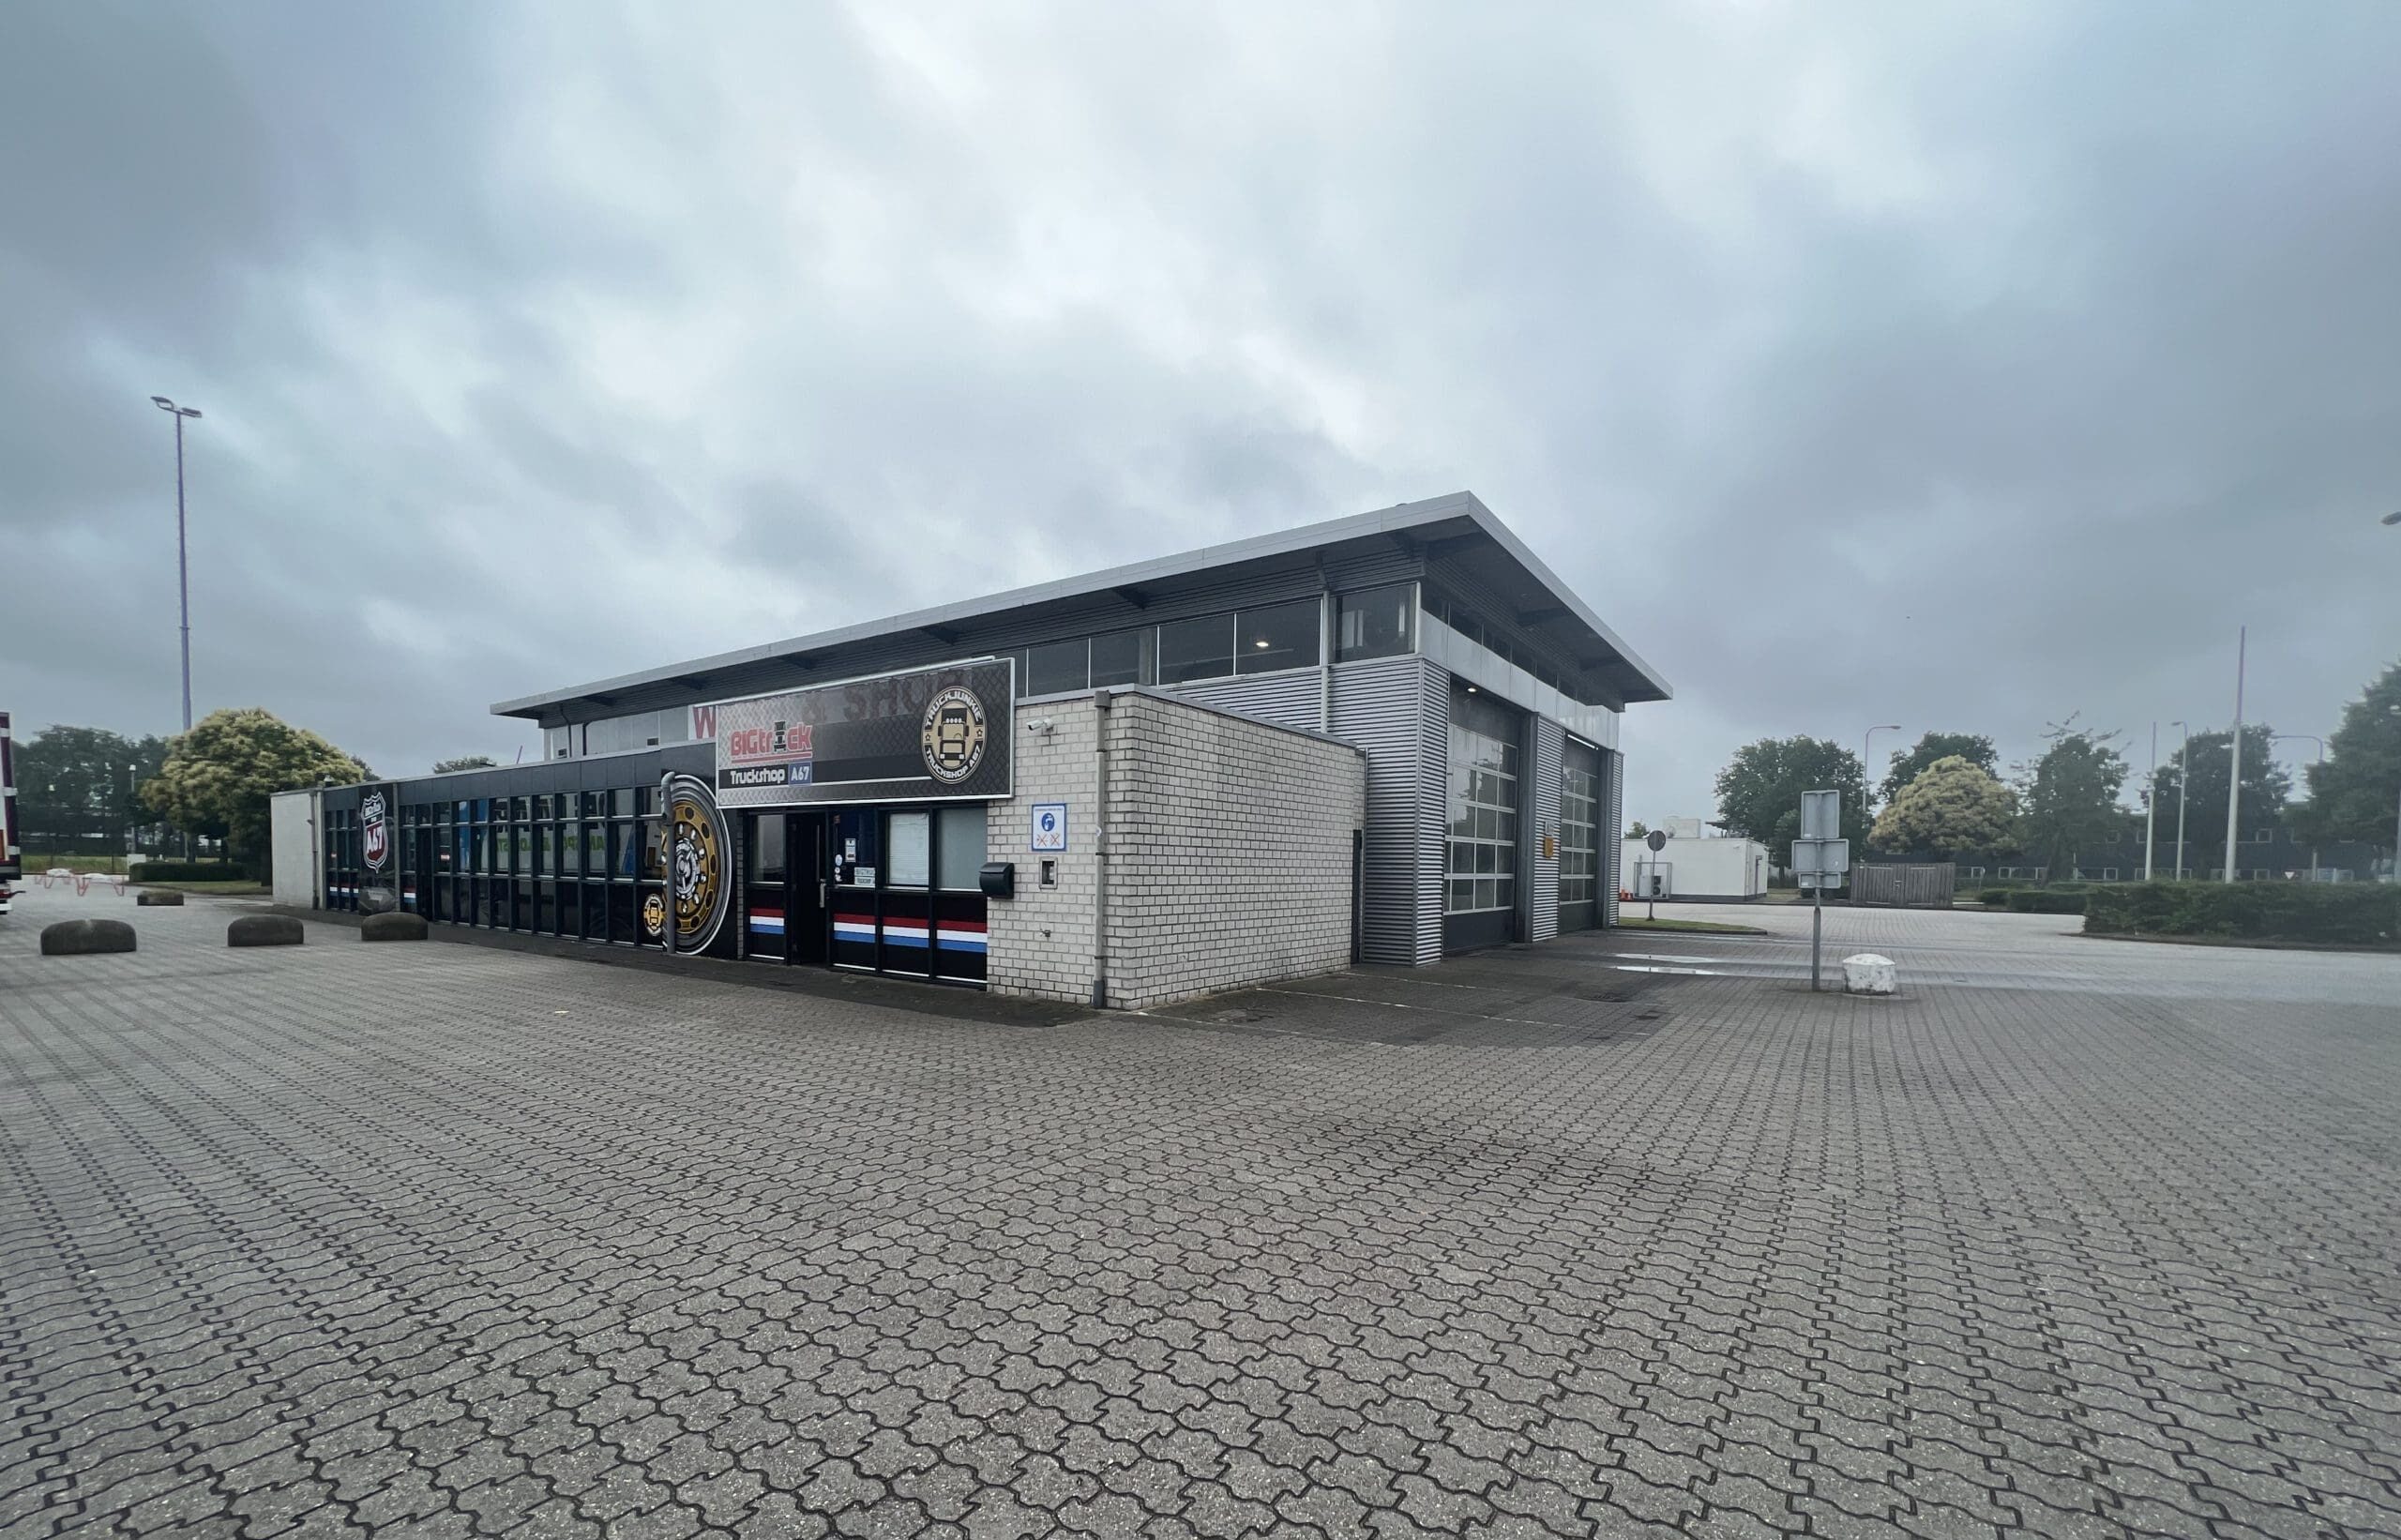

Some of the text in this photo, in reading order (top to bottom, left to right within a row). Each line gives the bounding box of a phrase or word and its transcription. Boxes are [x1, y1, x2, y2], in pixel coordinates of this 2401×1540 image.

[925, 690, 983, 727] TRUCKJUNKIE
[730, 765, 810, 785] Truckshop A67
[927, 744, 981, 779] TRUCKSHOP A67
[366, 826, 383, 854] A67
